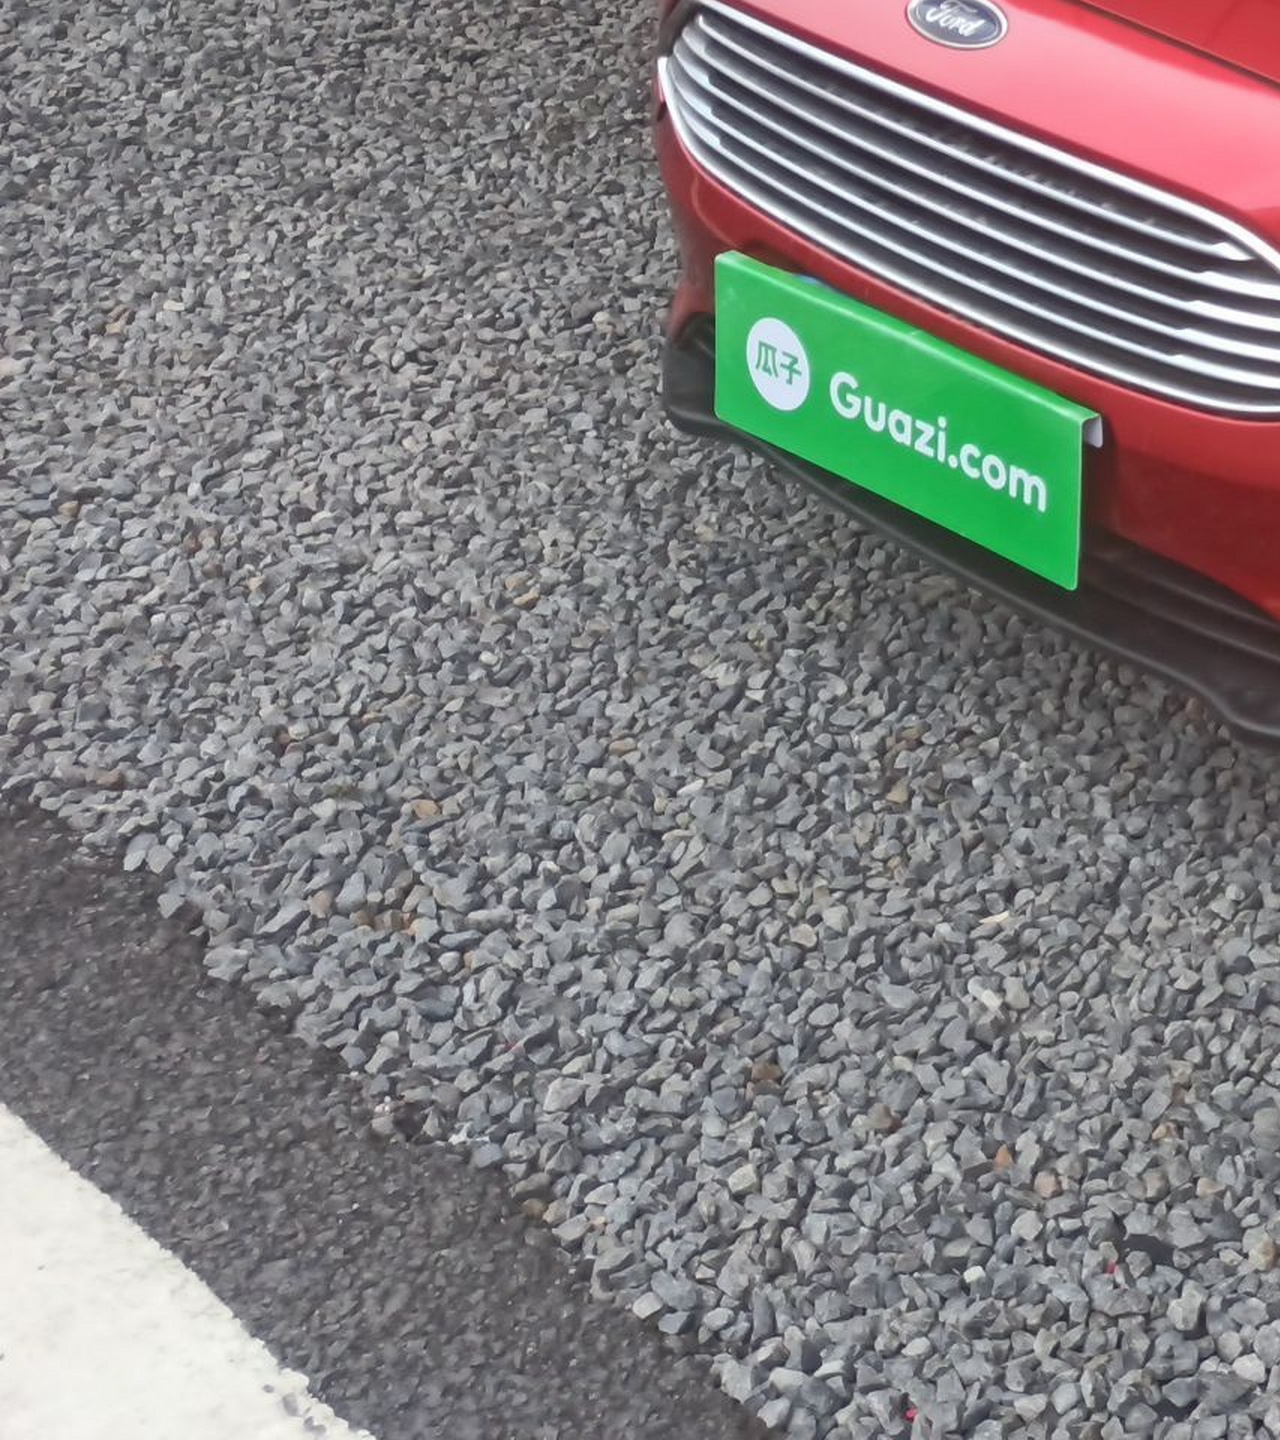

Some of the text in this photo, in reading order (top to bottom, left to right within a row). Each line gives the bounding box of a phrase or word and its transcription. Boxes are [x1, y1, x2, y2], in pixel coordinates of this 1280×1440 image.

[925, 0, 985, 37] Ford
[755, 339, 803, 386] 瓜子
[829, 371, 1048, 513] Guazi.com
